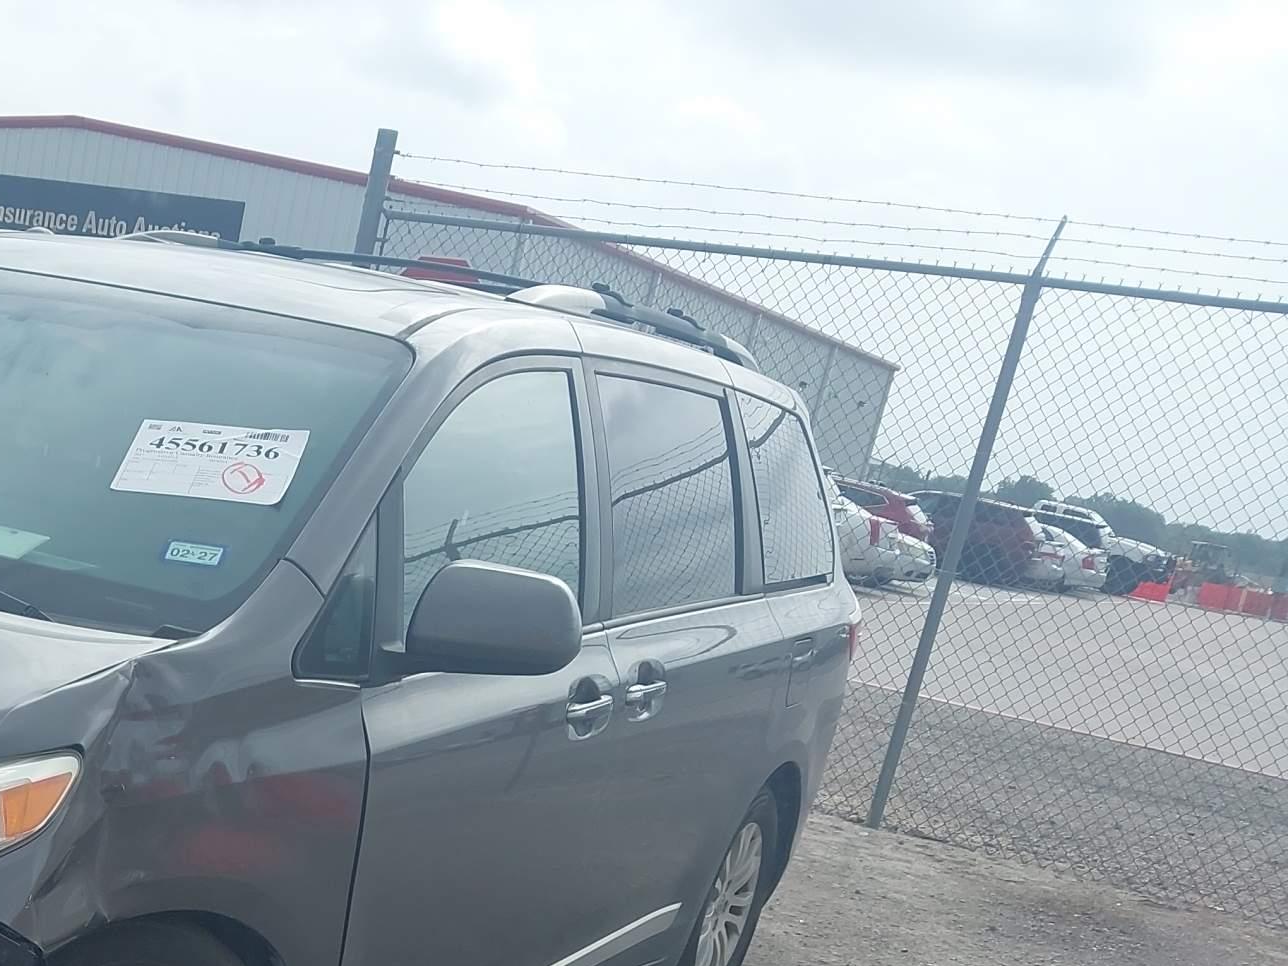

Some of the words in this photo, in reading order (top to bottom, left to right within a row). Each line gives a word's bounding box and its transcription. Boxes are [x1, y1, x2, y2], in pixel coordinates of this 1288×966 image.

[82, 210, 127, 238] Auto
[149, 436, 280, 460] 45561736
[170, 547, 191, 559] 02
[197, 551, 220, 562] 27
